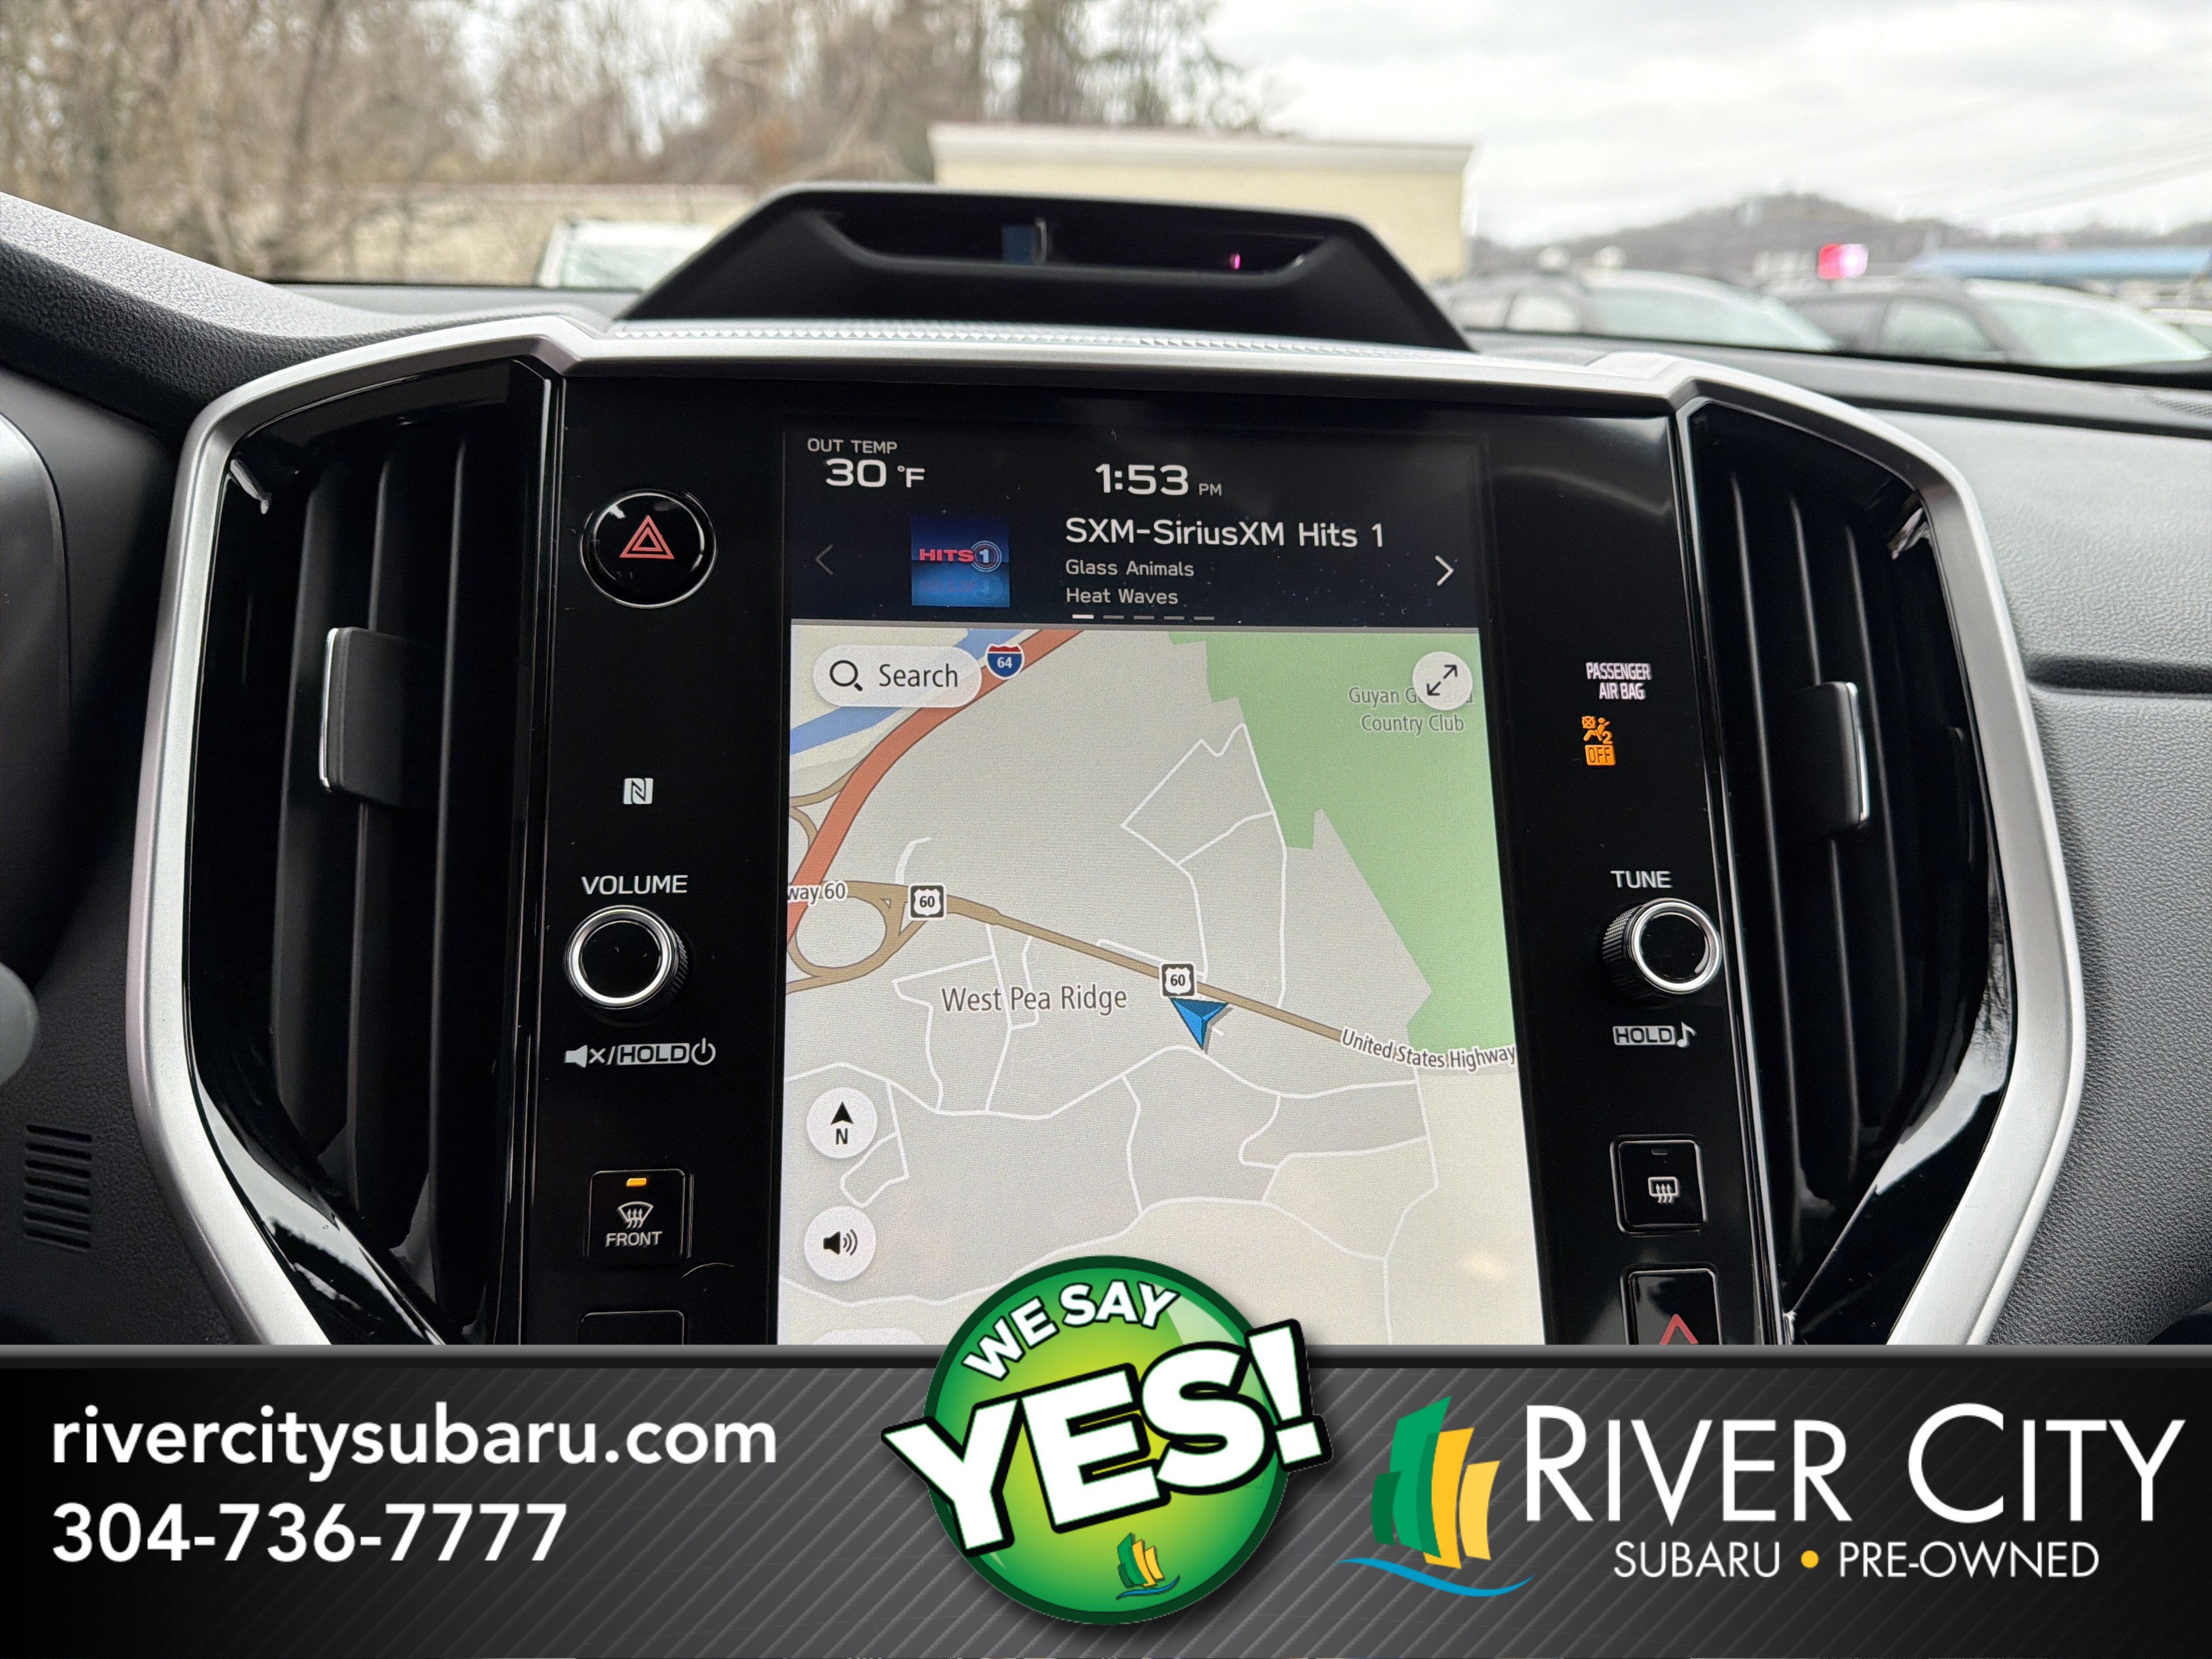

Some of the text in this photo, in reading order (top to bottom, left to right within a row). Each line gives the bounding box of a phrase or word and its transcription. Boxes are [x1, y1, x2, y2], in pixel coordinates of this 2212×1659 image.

[808, 438, 898, 454] OUT TEMP
[826, 458, 887, 487] 30
[1096, 464, 1222, 496] 1:53 PM
[1065, 517, 1383, 547] SXM-SiriusXM Hits 1
[1065, 558, 1194, 577] Glass Animals
[1066, 588, 1178, 605] Heat Waves
[997, 657, 1012, 669] 64
[1586, 662, 1652, 680] PASSENGER
[879, 663, 958, 687] Search
[1349, 687, 1400, 708] Guyan
[1599, 682, 1646, 700] AIR BAG
[1362, 714, 1464, 736] Country Club
[1588, 747, 1611, 763] OFF
[582, 874, 688, 895] VOLUME
[1611, 871, 1672, 888] TUNE
[825, 883, 845, 899] 60
[919, 895, 935, 909] 60
[1170, 974, 1186, 987] 60
[942, 984, 1127, 1015] West Pea Ridge
[1615, 1027, 1673, 1043] HOLD
[1342, 1028, 1515, 1072] United States Highway
[836, 1128, 848, 1145] N
[605, 1231, 663, 1247] FRONT
